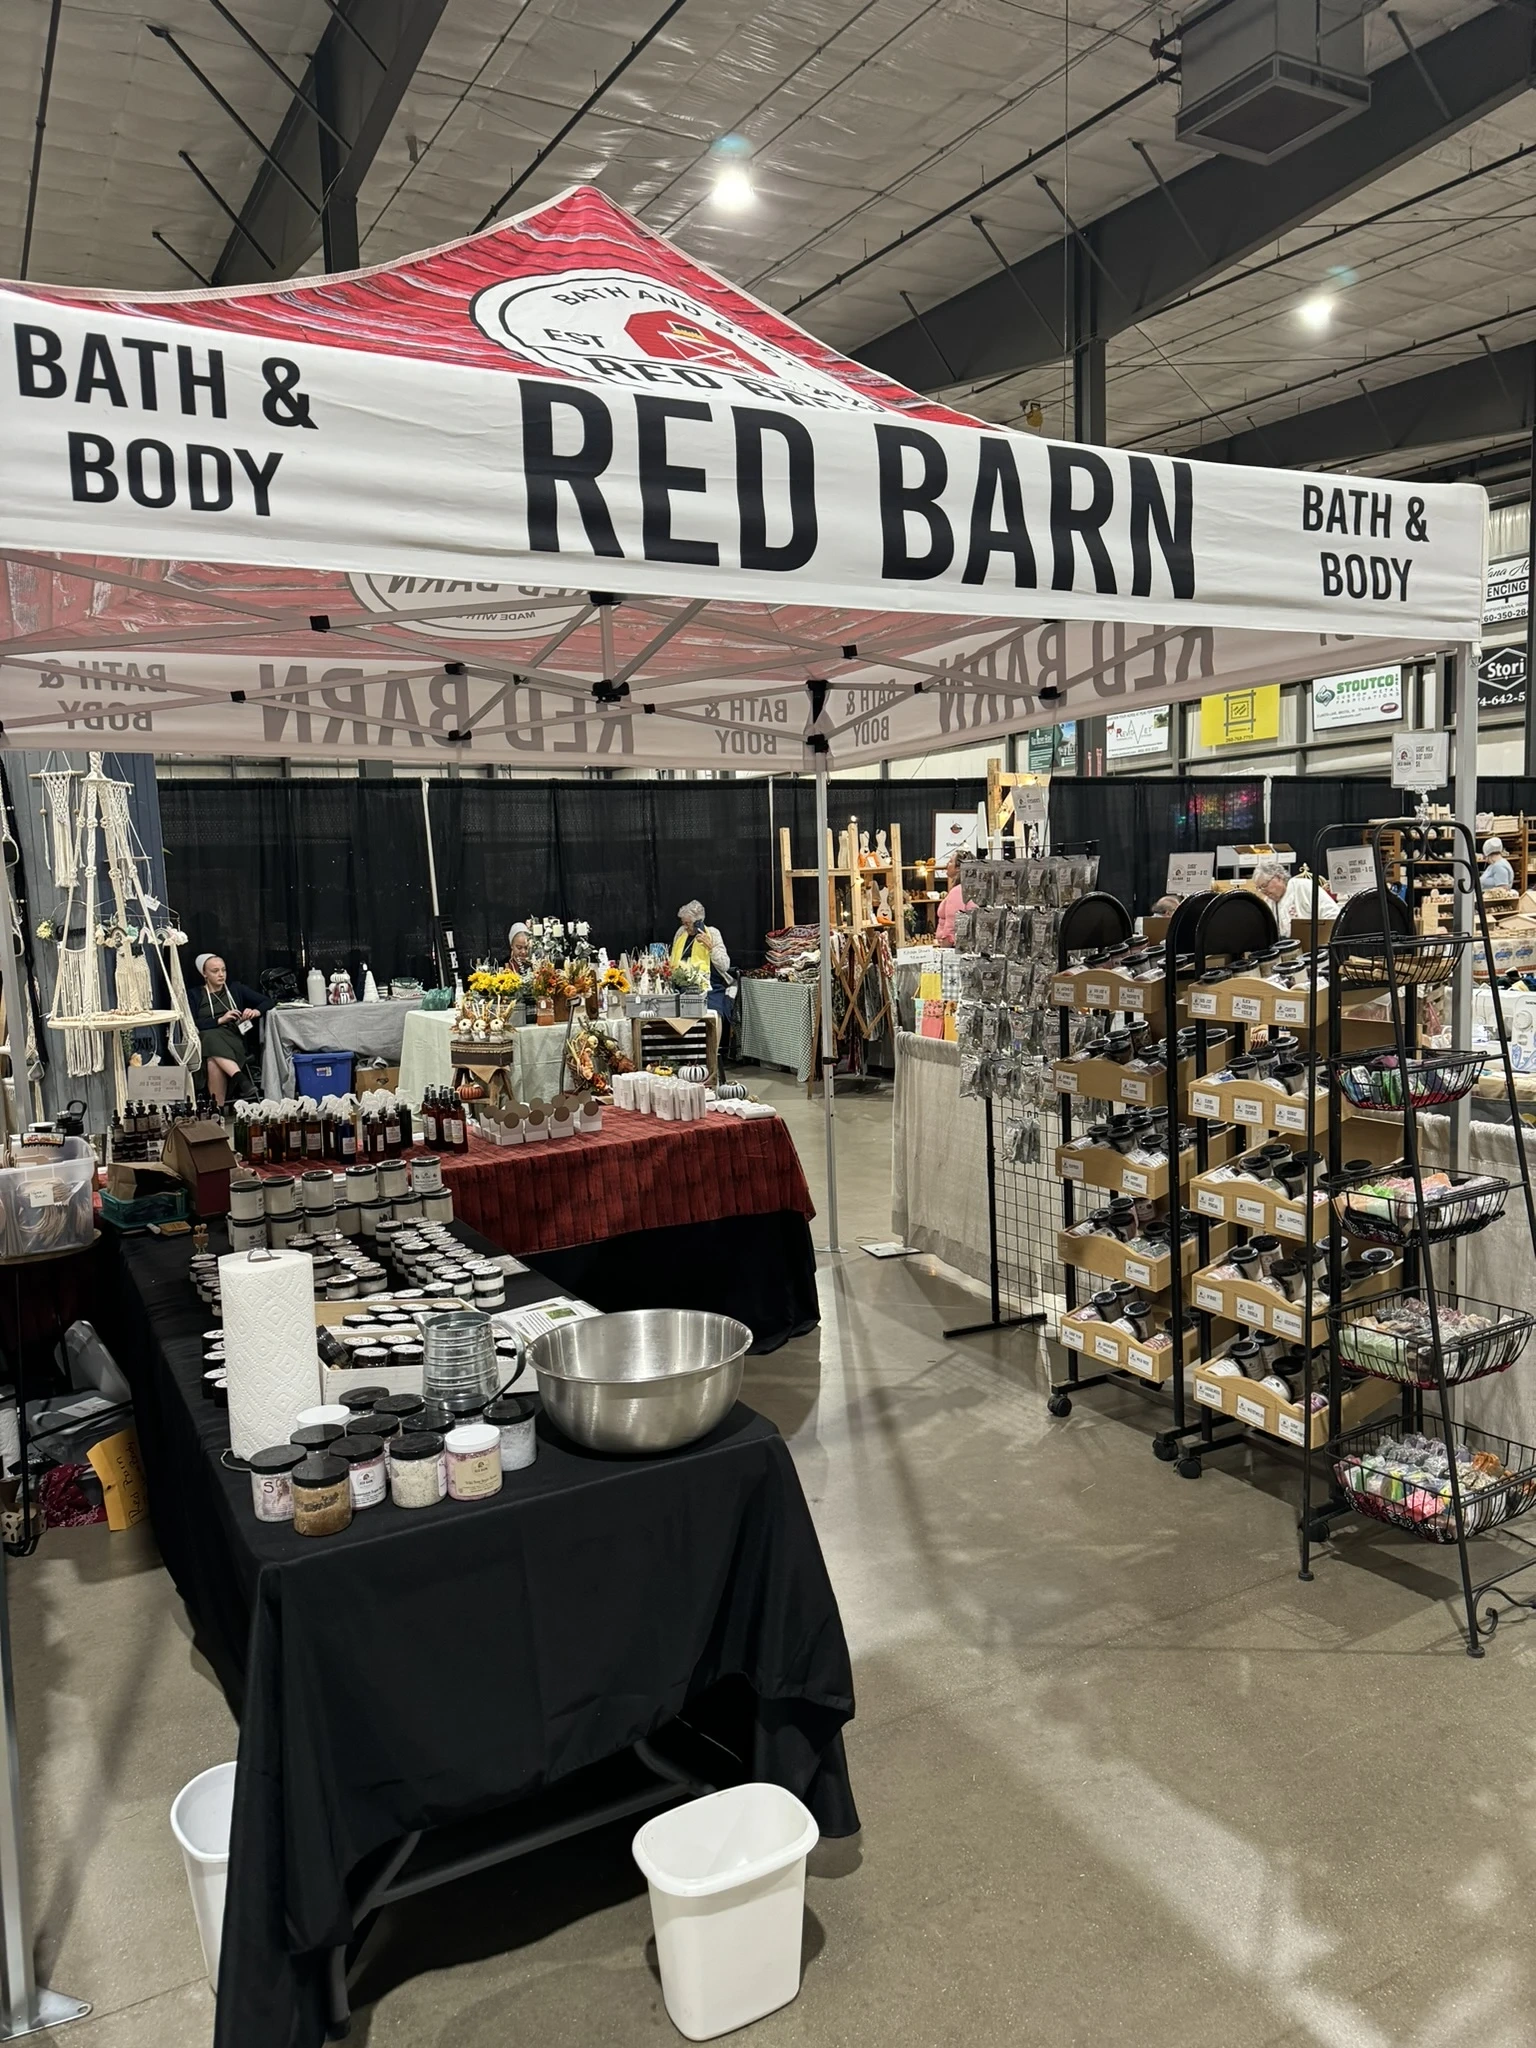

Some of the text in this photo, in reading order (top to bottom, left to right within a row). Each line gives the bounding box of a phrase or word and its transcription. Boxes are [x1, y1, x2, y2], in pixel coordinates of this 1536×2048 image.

[542, 328, 607, 348] EST
[552, 285, 804, 370] BATH AND BODY
[13, 322, 320, 430] BATH &
[584, 357, 723, 390] RED
[68, 431, 284, 517] BODY
[517, 378, 1196, 600] RED BARN
[1302, 484, 1430, 543] BATH &
[1320, 551, 1414, 603] BODY
[1487, 580, 1527, 598] ENCING
[1482, 608, 1529, 623] 60-350-28
[1336, 674, 1394, 694] STOUTCO
[1487, 658, 1524, 679] Stori
[1336, 693, 1399, 704] FABRICATIONS
[1477, 691, 1526, 707] 4-642-5
[128, 1492, 143, 1524] Red
